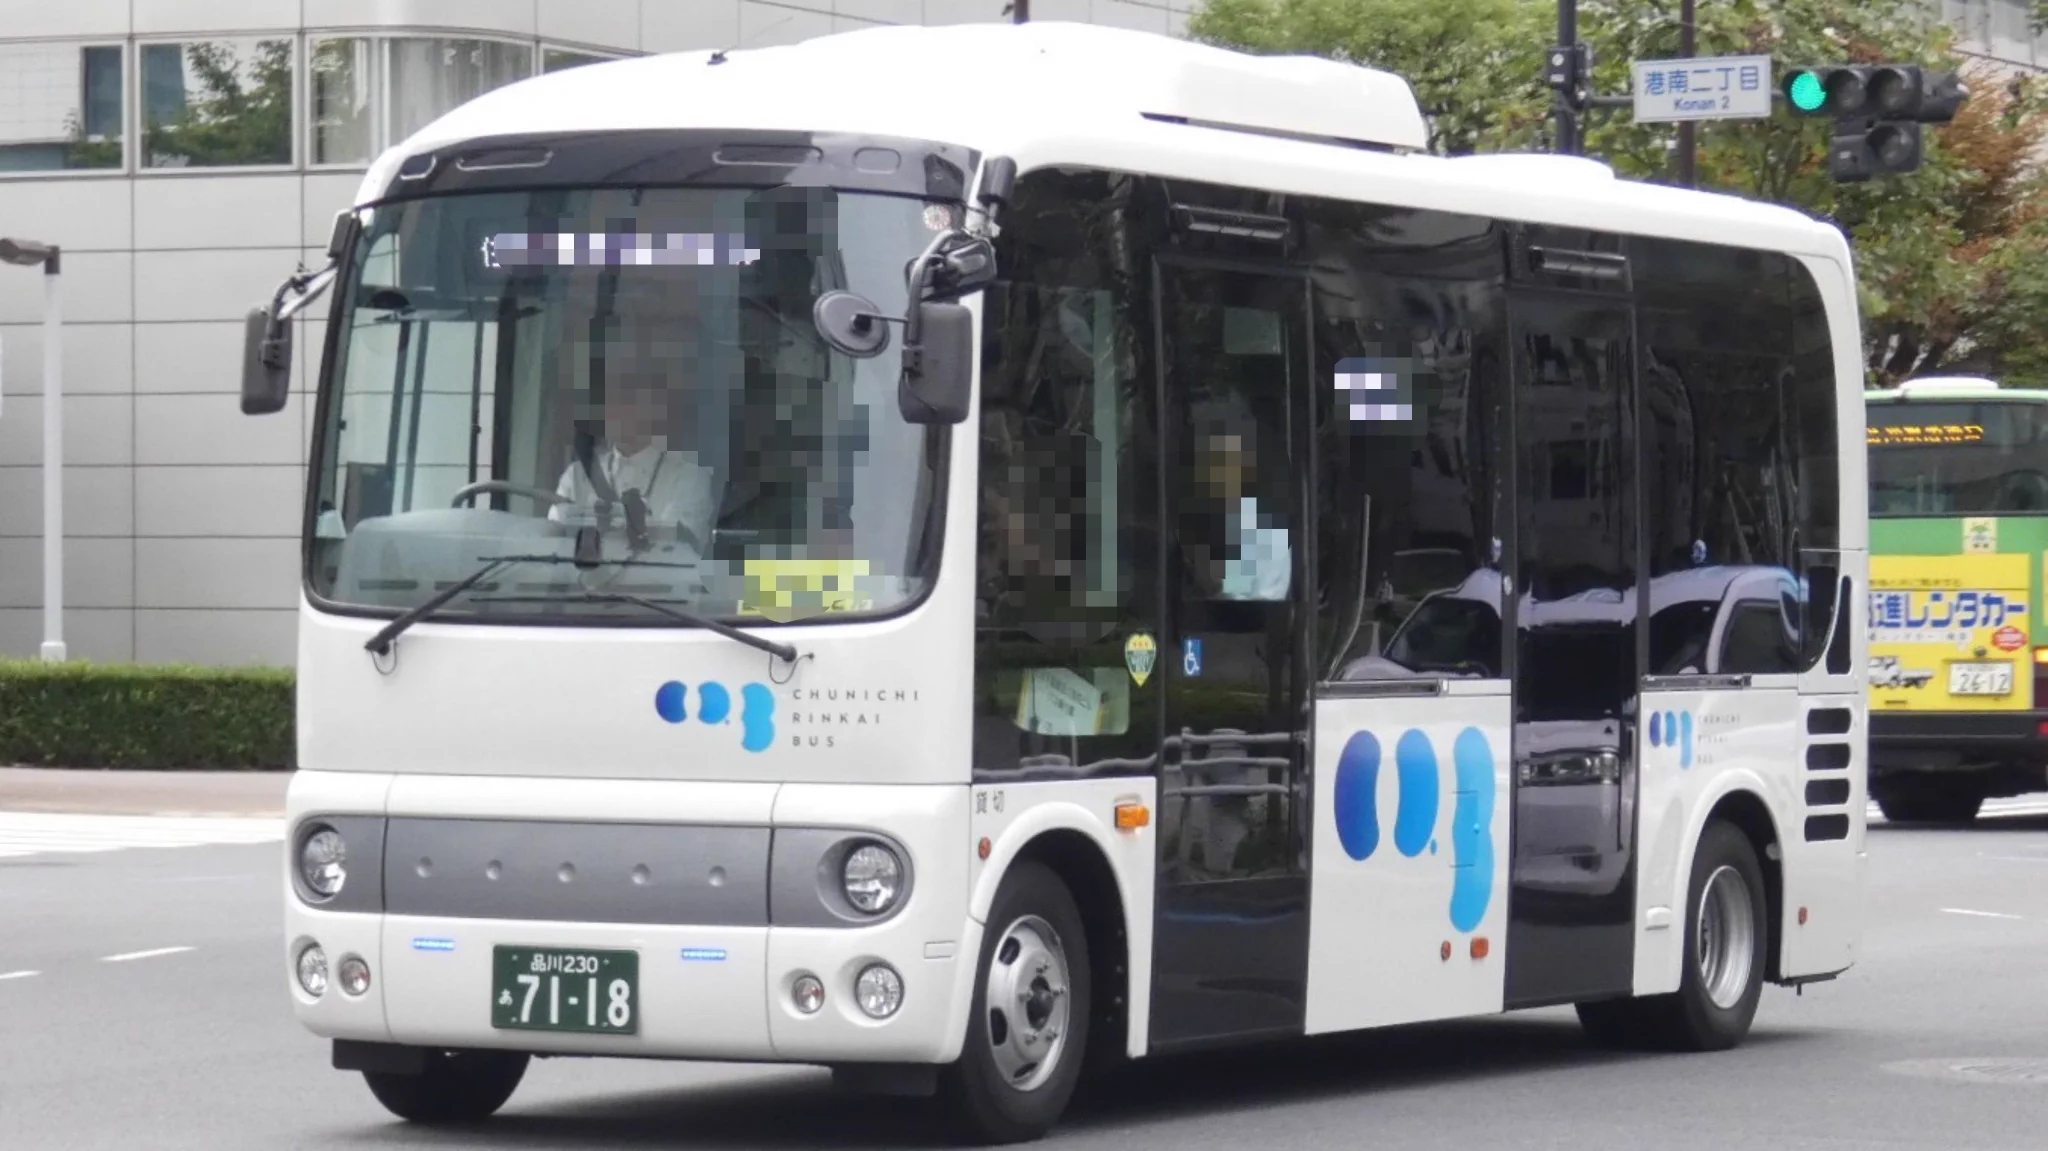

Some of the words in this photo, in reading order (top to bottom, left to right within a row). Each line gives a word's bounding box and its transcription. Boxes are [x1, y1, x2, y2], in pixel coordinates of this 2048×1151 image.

[1645, 66, 1759, 95] 港南二丁目
[1674, 98, 1716, 111] Konan
[1721, 96, 1730, 109] 2
[1868, 591, 2025, 628] 進レンタカー
[792, 689, 919, 702] CHUNICHI
[792, 712, 880, 725] RINKAI
[792, 736, 835, 747] BUS
[498, 988, 513, 1006] あ
[517, 974, 630, 1027] 71-18
